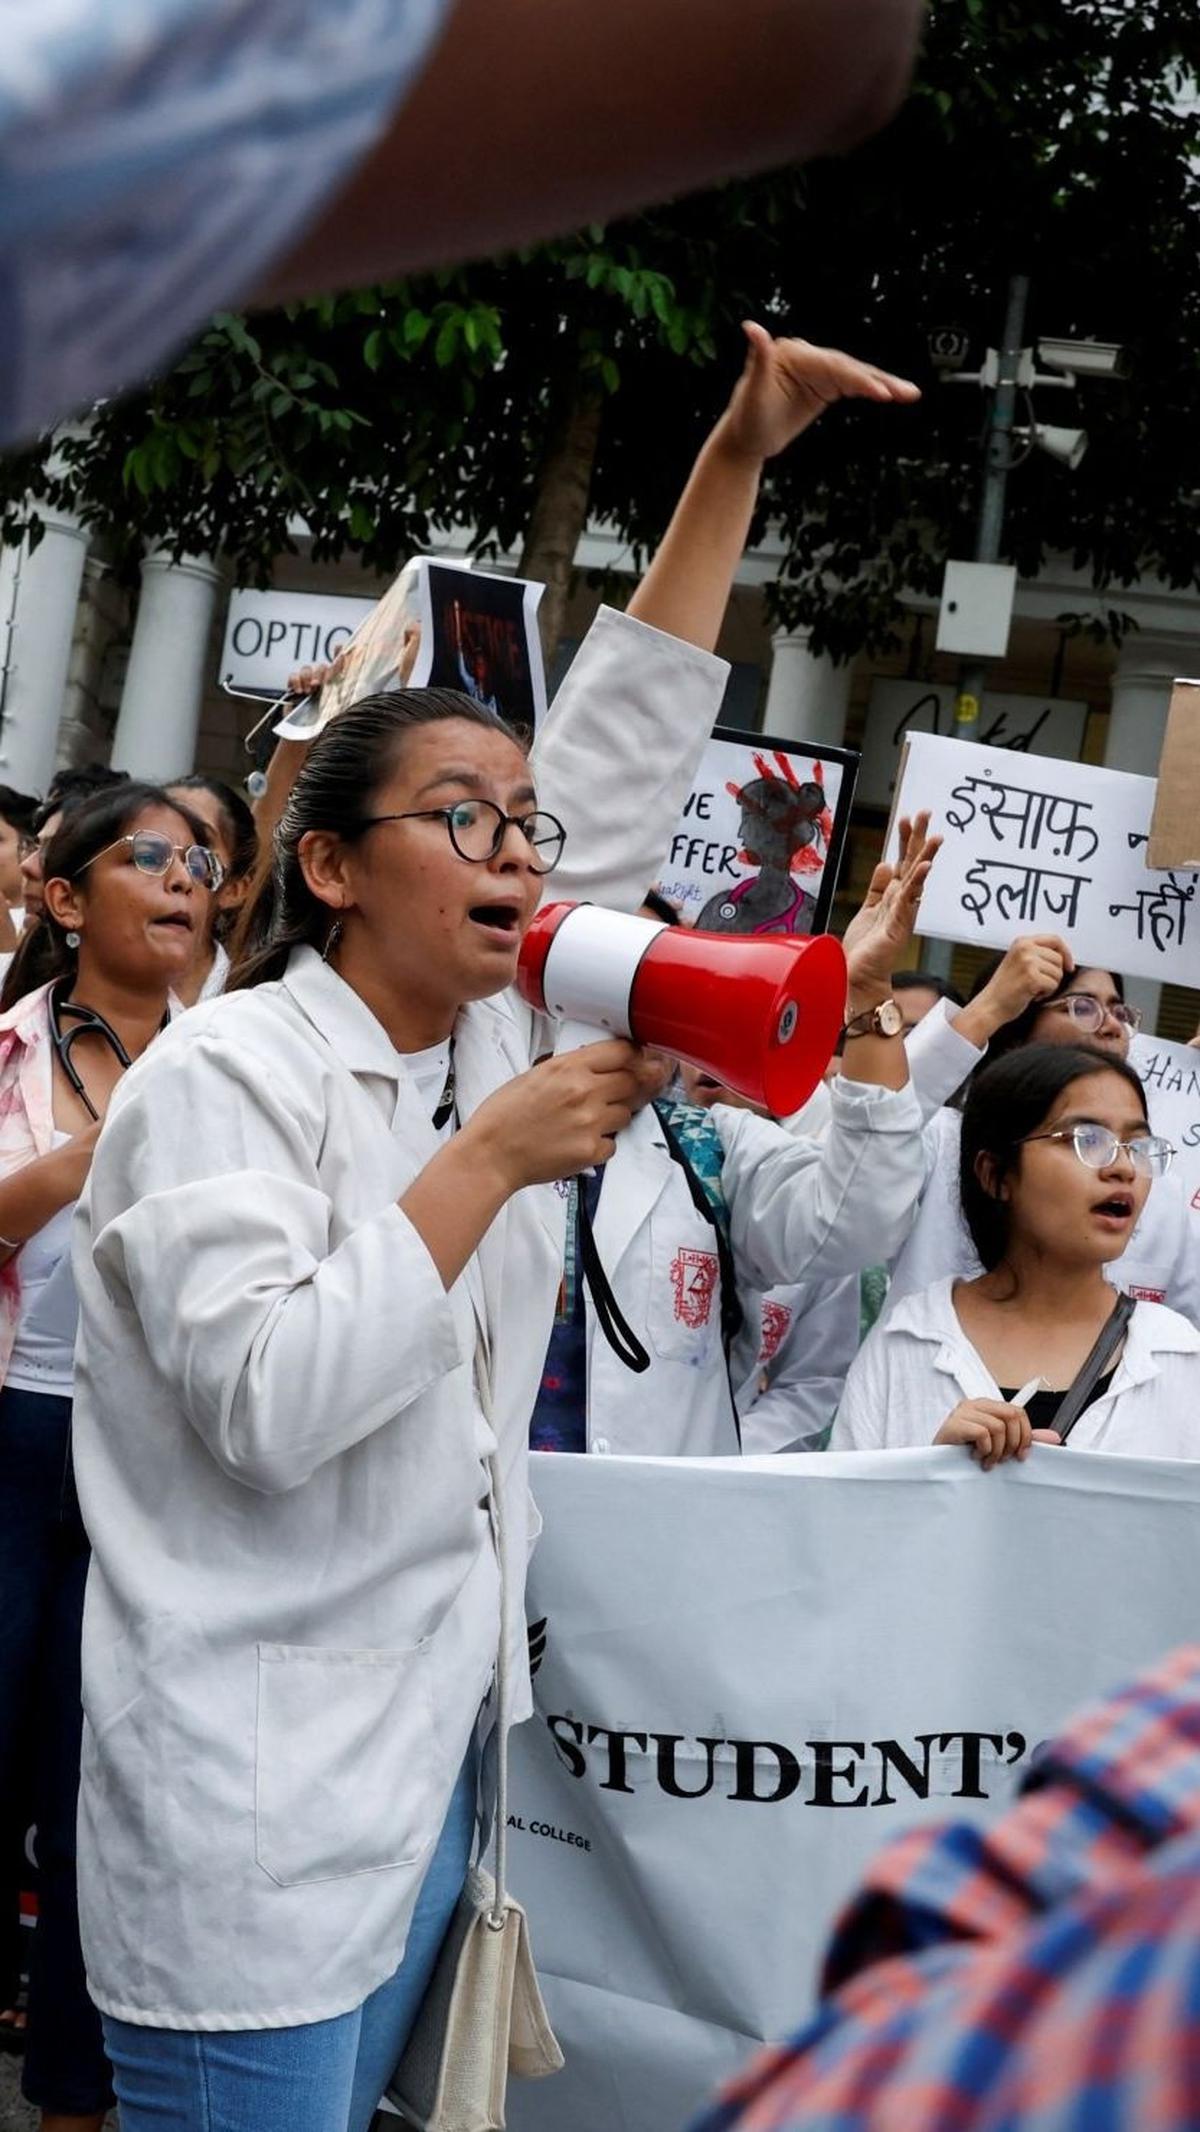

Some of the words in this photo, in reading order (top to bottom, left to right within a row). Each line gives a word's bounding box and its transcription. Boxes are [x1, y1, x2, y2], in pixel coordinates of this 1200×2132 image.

[961, 859, 1093, 927] इलाज
[1109, 883, 1195, 951] नहीं
[547, 1714, 1045, 1807] STUDENT’
[529, 1821, 592, 1852] COLLEGE
